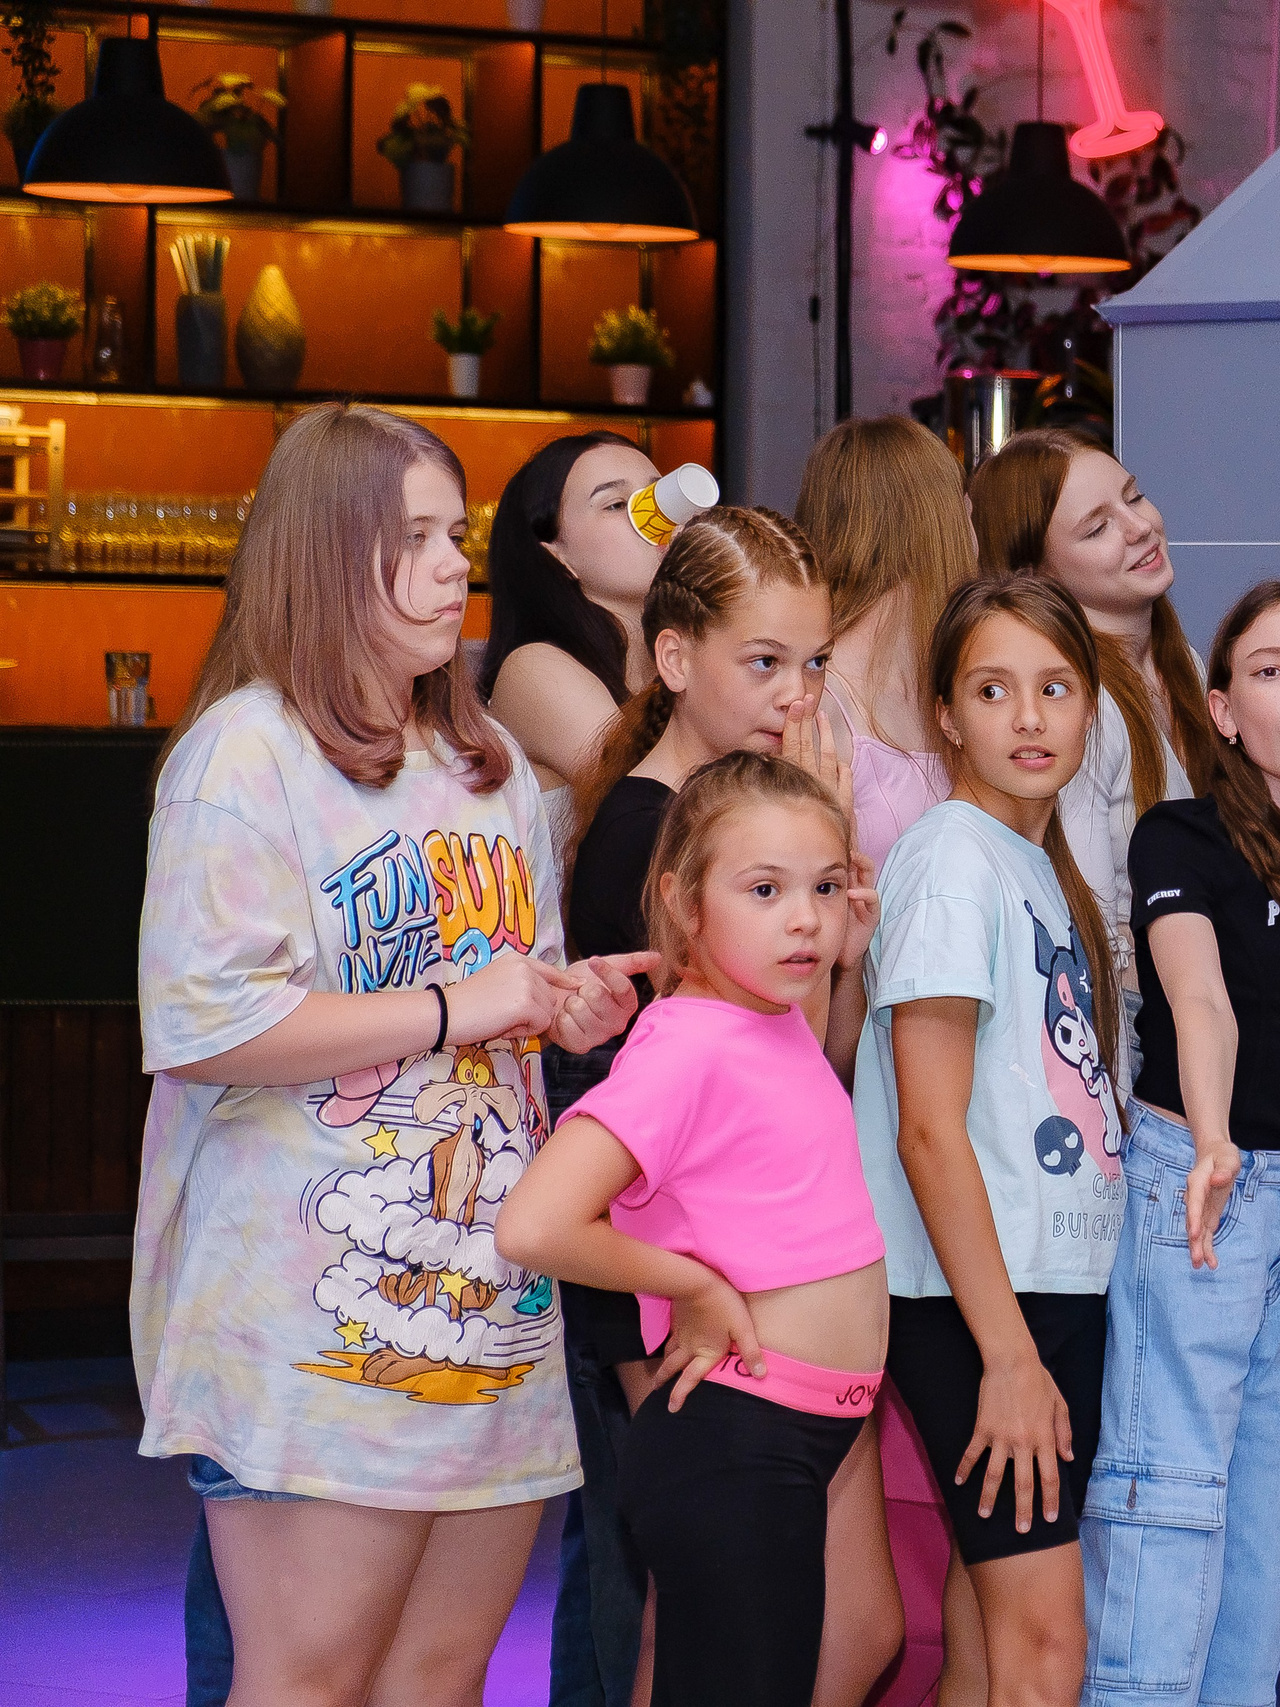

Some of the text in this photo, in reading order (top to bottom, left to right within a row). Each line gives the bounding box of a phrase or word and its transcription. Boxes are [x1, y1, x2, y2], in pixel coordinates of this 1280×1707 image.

[320, 830, 430, 949] FUN
[423, 829, 536, 960] SUN
[377, 914, 442, 989] THE
